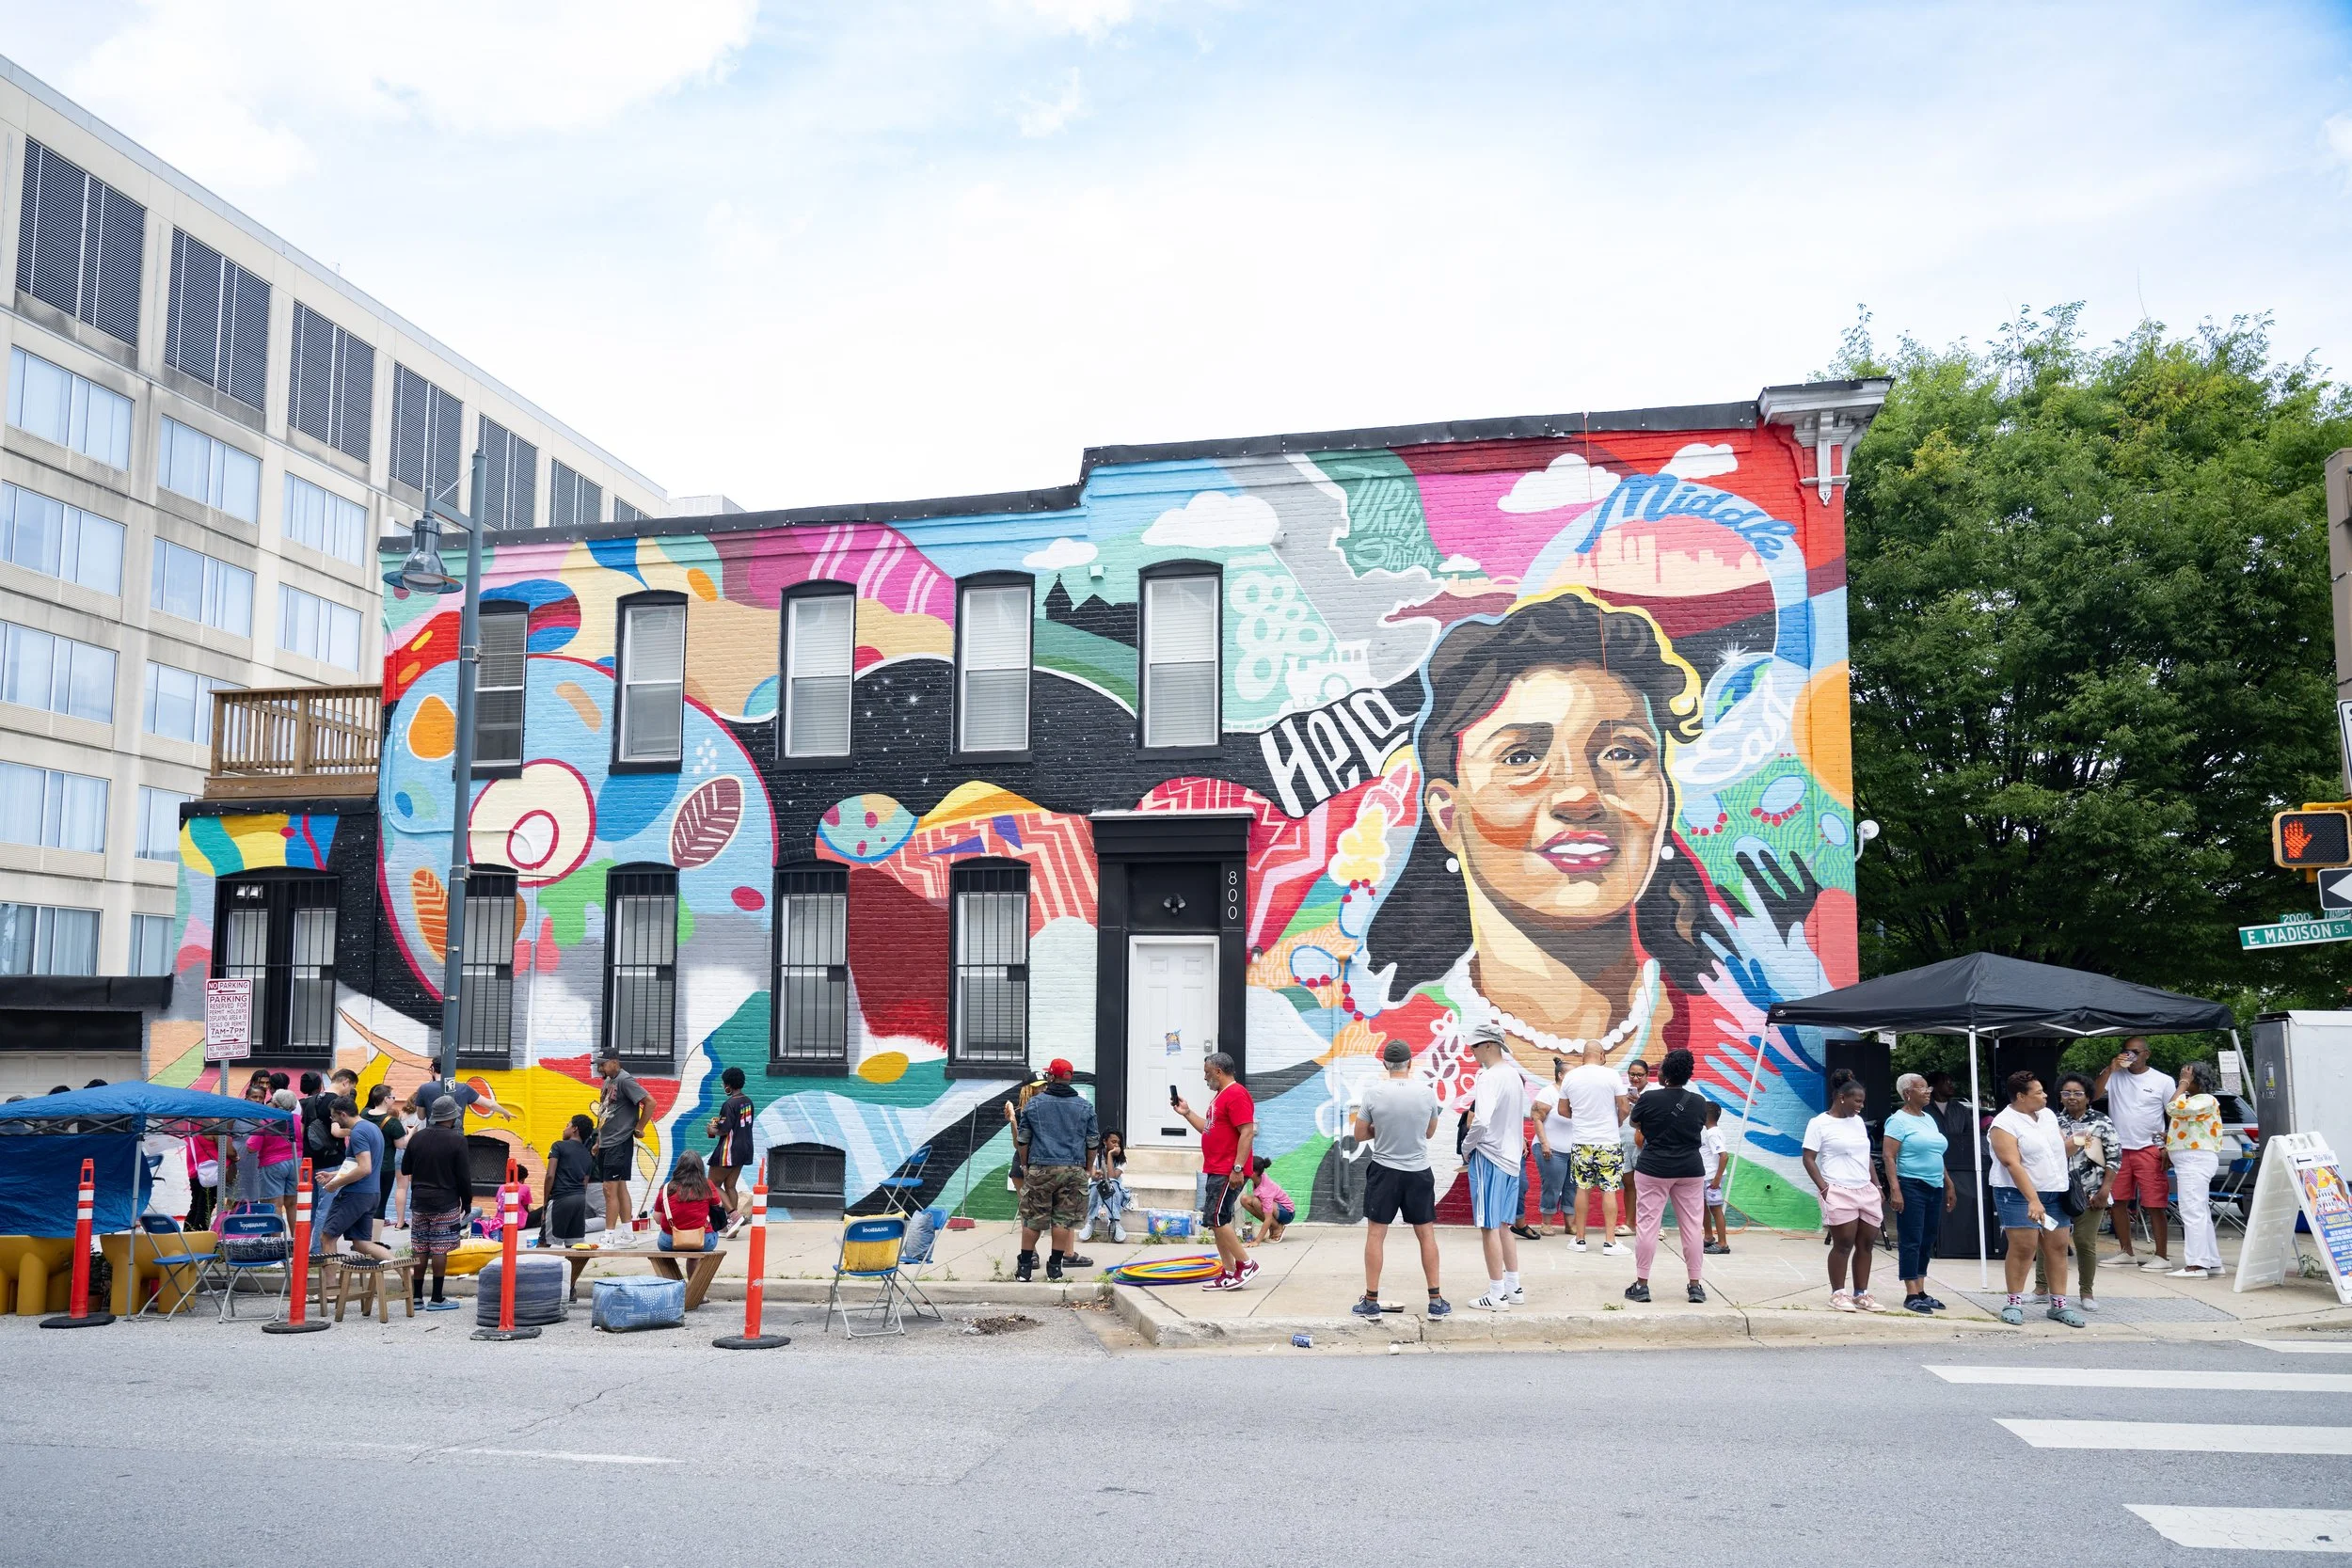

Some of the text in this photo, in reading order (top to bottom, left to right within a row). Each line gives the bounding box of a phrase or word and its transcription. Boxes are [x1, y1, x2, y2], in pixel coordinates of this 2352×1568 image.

[1574, 473, 1797, 561] Middle
[1670, 669, 1791, 784] East
[1228, 870, 1238, 920] 800
[2247, 924, 2349, 945] E. MADISON ST.
